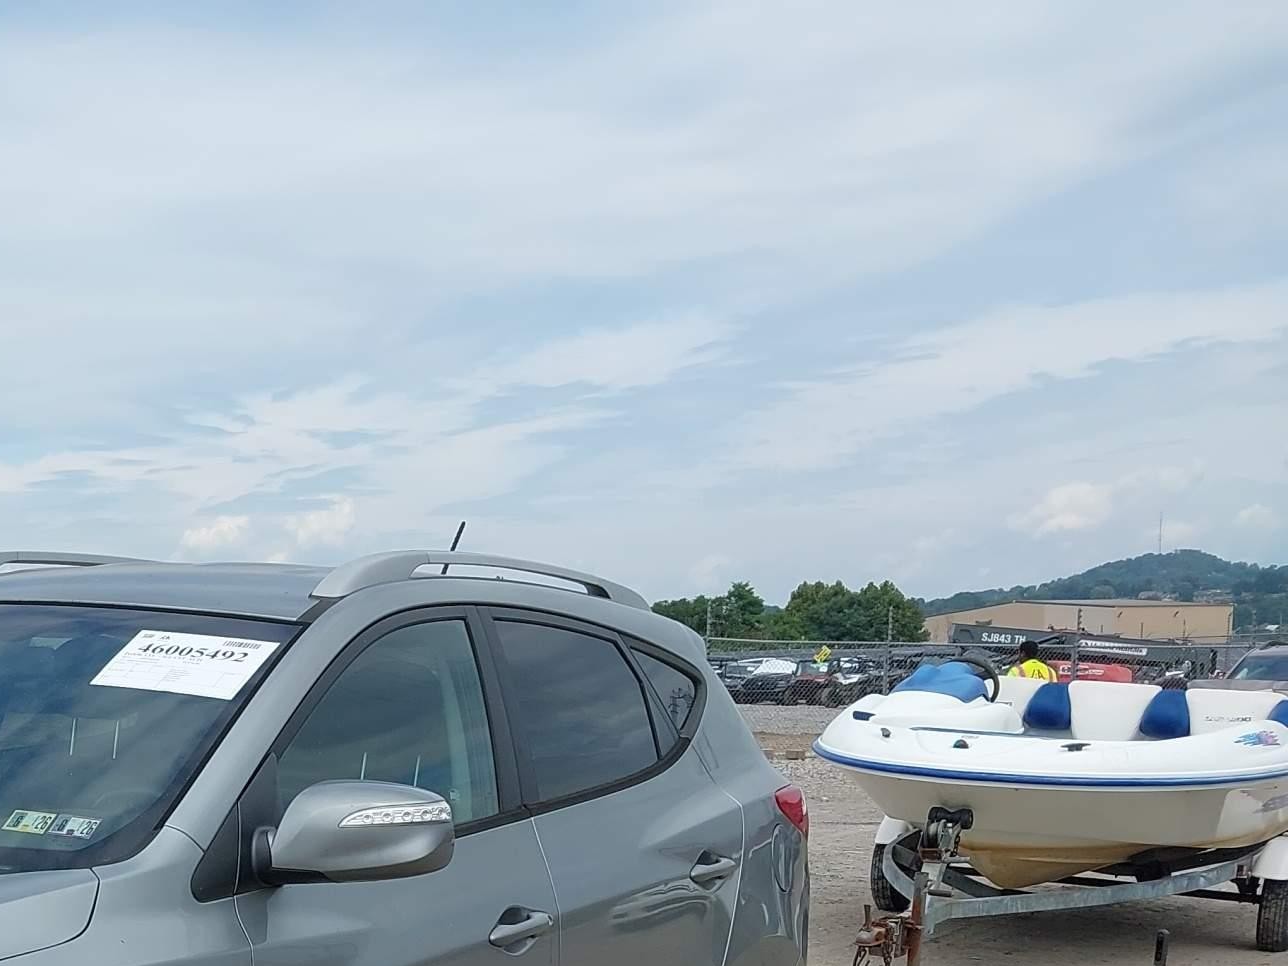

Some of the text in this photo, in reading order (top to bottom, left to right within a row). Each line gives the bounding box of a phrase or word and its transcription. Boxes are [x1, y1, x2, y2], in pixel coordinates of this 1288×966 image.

[981, 632, 1027, 644] SJ843 TH
[138, 643, 249, 663] 46005492
